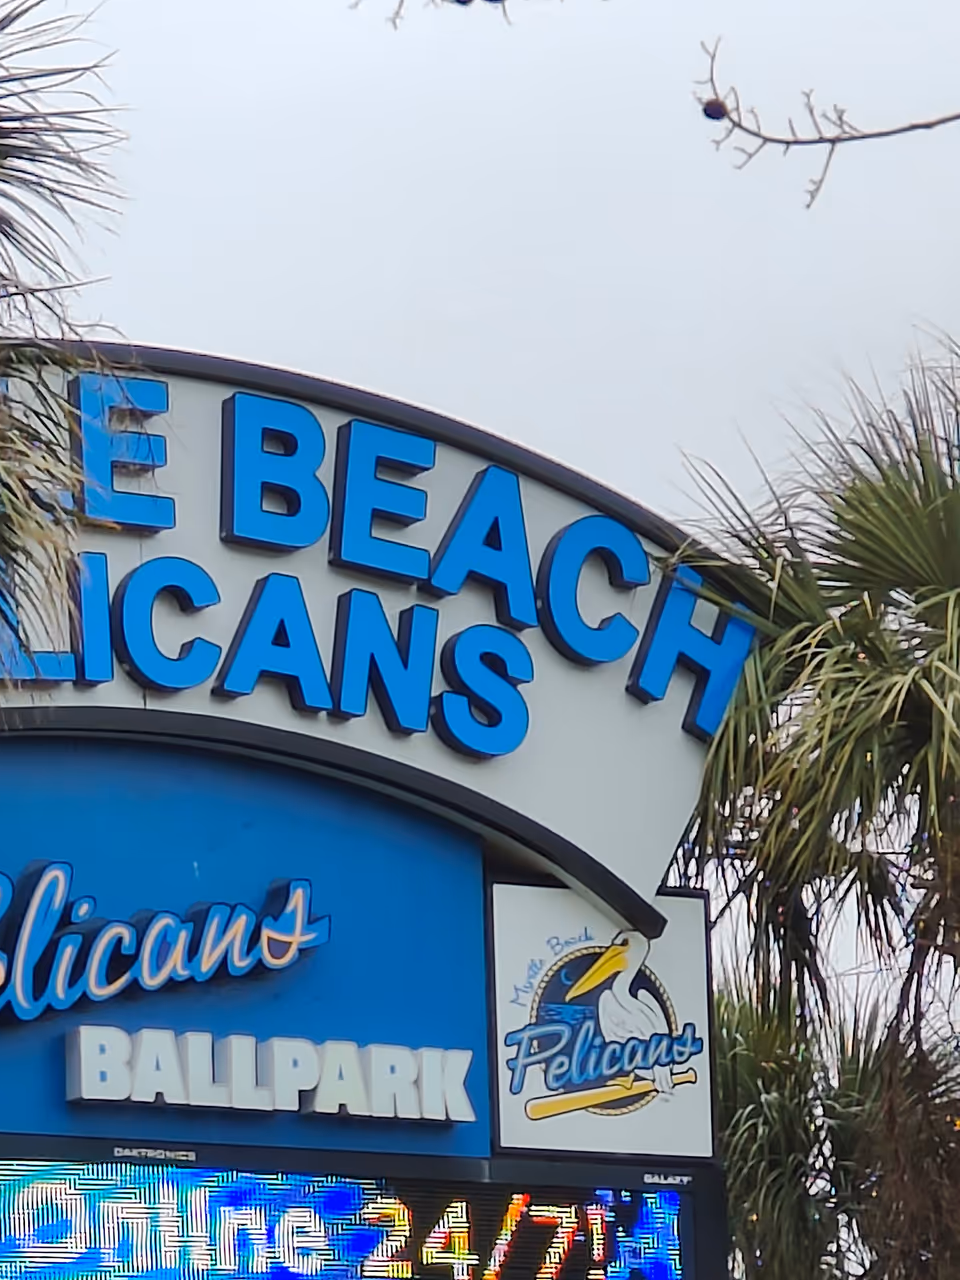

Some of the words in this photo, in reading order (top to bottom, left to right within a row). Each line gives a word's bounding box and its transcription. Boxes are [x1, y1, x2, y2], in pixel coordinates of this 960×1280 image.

[222, 391, 756, 742] BEACH
[66, 1024, 477, 1122] BALLPARK
[504, 1022, 704, 1096] Pelicans
